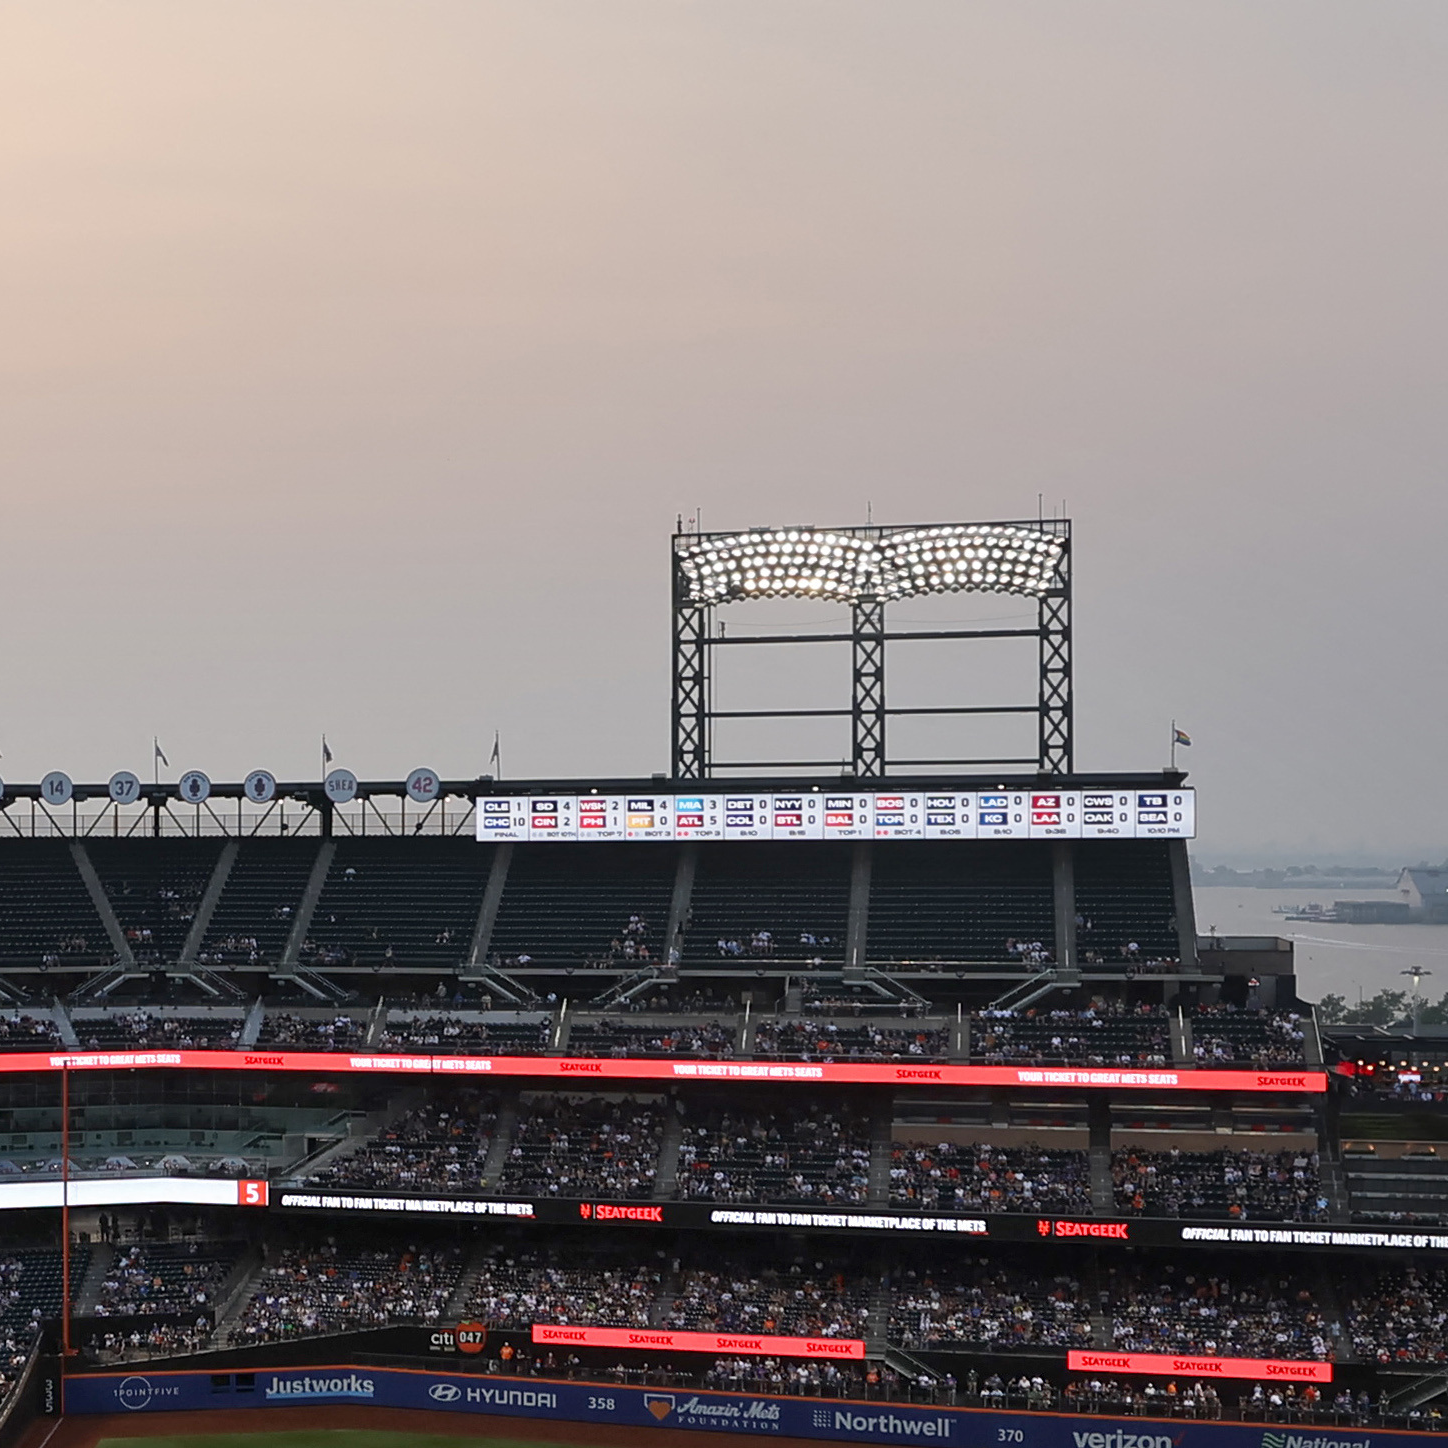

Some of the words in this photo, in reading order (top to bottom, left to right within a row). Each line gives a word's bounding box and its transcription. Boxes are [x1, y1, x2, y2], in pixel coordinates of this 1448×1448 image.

[49, 780, 63, 795] 14
[115, 780, 134, 795] 37
[329, 779, 353, 792] SHEA
[412, 777, 433, 793] 42
[486, 803, 509, 811] CLE
[536, 802, 553, 810] SD
[580, 802, 605, 810] WSH
[631, 802, 651, 810] MIL
[728, 801, 752, 809] DET
[828, 800, 851, 808] MIN
[877, 800, 903, 808] BOS
[928, 799, 954, 807] HOU
[981, 798, 1007, 806] LAD
[583, 818, 603, 826] PHI
[632, 818, 650, 826] PIT
[680, 817, 701, 825] ATL
[928, 815, 954, 823] TEX
[1033, 814, 1059, 822] LAA
[561, 1063, 602, 1072] SEATGEEK
[674, 1065, 697, 1074] YOUR
[698, 1065, 727, 1075] TICKET
[729, 1066, 739, 1075] TO
[741, 1066, 769, 1076] GREAT
[770, 1067, 794, 1076] METS
[795, 1068, 822, 1077] SEATS
[896, 1070, 941, 1079] SEATGEEK
[1018, 1072, 1043, 1082] YOUR
[1044, 1072, 1076, 1082] TICKET
[1077, 1072, 1089, 1082] TO
[1091, 1073, 1120, 1083] GREAT
[1122, 1073, 1147, 1083] METS
[1148, 1074, 1177, 1084] SEATS
[1257, 1077, 1305, 1086] SEATGEEK
[245, 1184, 259, 1204] 5
[597, 1205, 662, 1221] SEATGEEK
[711, 1211, 754, 1223] OFFICIAL
[756, 1212, 776, 1224] FAN
[777, 1213, 790, 1224] TO
[791, 1213, 811, 1225] FAN
[812, 1214, 847, 1226] TICKET
[848, 1216, 921, 1230] MARKETPLACE
[922, 1218, 936, 1230] OF
[937, 1219, 957, 1231] THE
[958, 1220, 986, 1232] METS
[1056, 1222, 1128, 1238] SEATGEEK
[1182, 1228, 1229, 1240] OFFICIAL
[1231, 1230, 1252, 1241] FAN
[1254, 1230, 1269, 1242] TO
[1270, 1231, 1292, 1243] FAN
[1293, 1232, 1330, 1244] TICKET
[1332, 1233, 1412, 1247] MARKETPLACE
[1414, 1236, 1428, 1247] OF
[430, 1331, 454, 1345] citi
[459, 1331, 482, 1344] 047
[542, 1330, 587, 1342] SEATGEEK
[629, 1334, 673, 1346] SEATGEEK
[717, 1338, 762, 1350] SEATGEEK
[806, 1342, 853, 1354] SEATGEEK
[1082, 1356, 1130, 1369] SEATGEEK
[1173, 1360, 1223, 1373] SEATGEEK
[1267, 1365, 1316, 1377] SEATGEEK
[266, 1374, 375, 1395] Justworks
[113, 1387, 179, 1397] 1POINTFIVE
[467, 1387, 557, 1409] HYUNDAI
[588, 1397, 615, 1410] 358
[677, 1397, 743, 1418] Amazin'
[744, 1400, 780, 1420] Mets
[678, 1415, 780, 1431] FOUNDATION
[835, 1411, 950, 1438] Northwell
[998, 1428, 1024, 1443] 370
